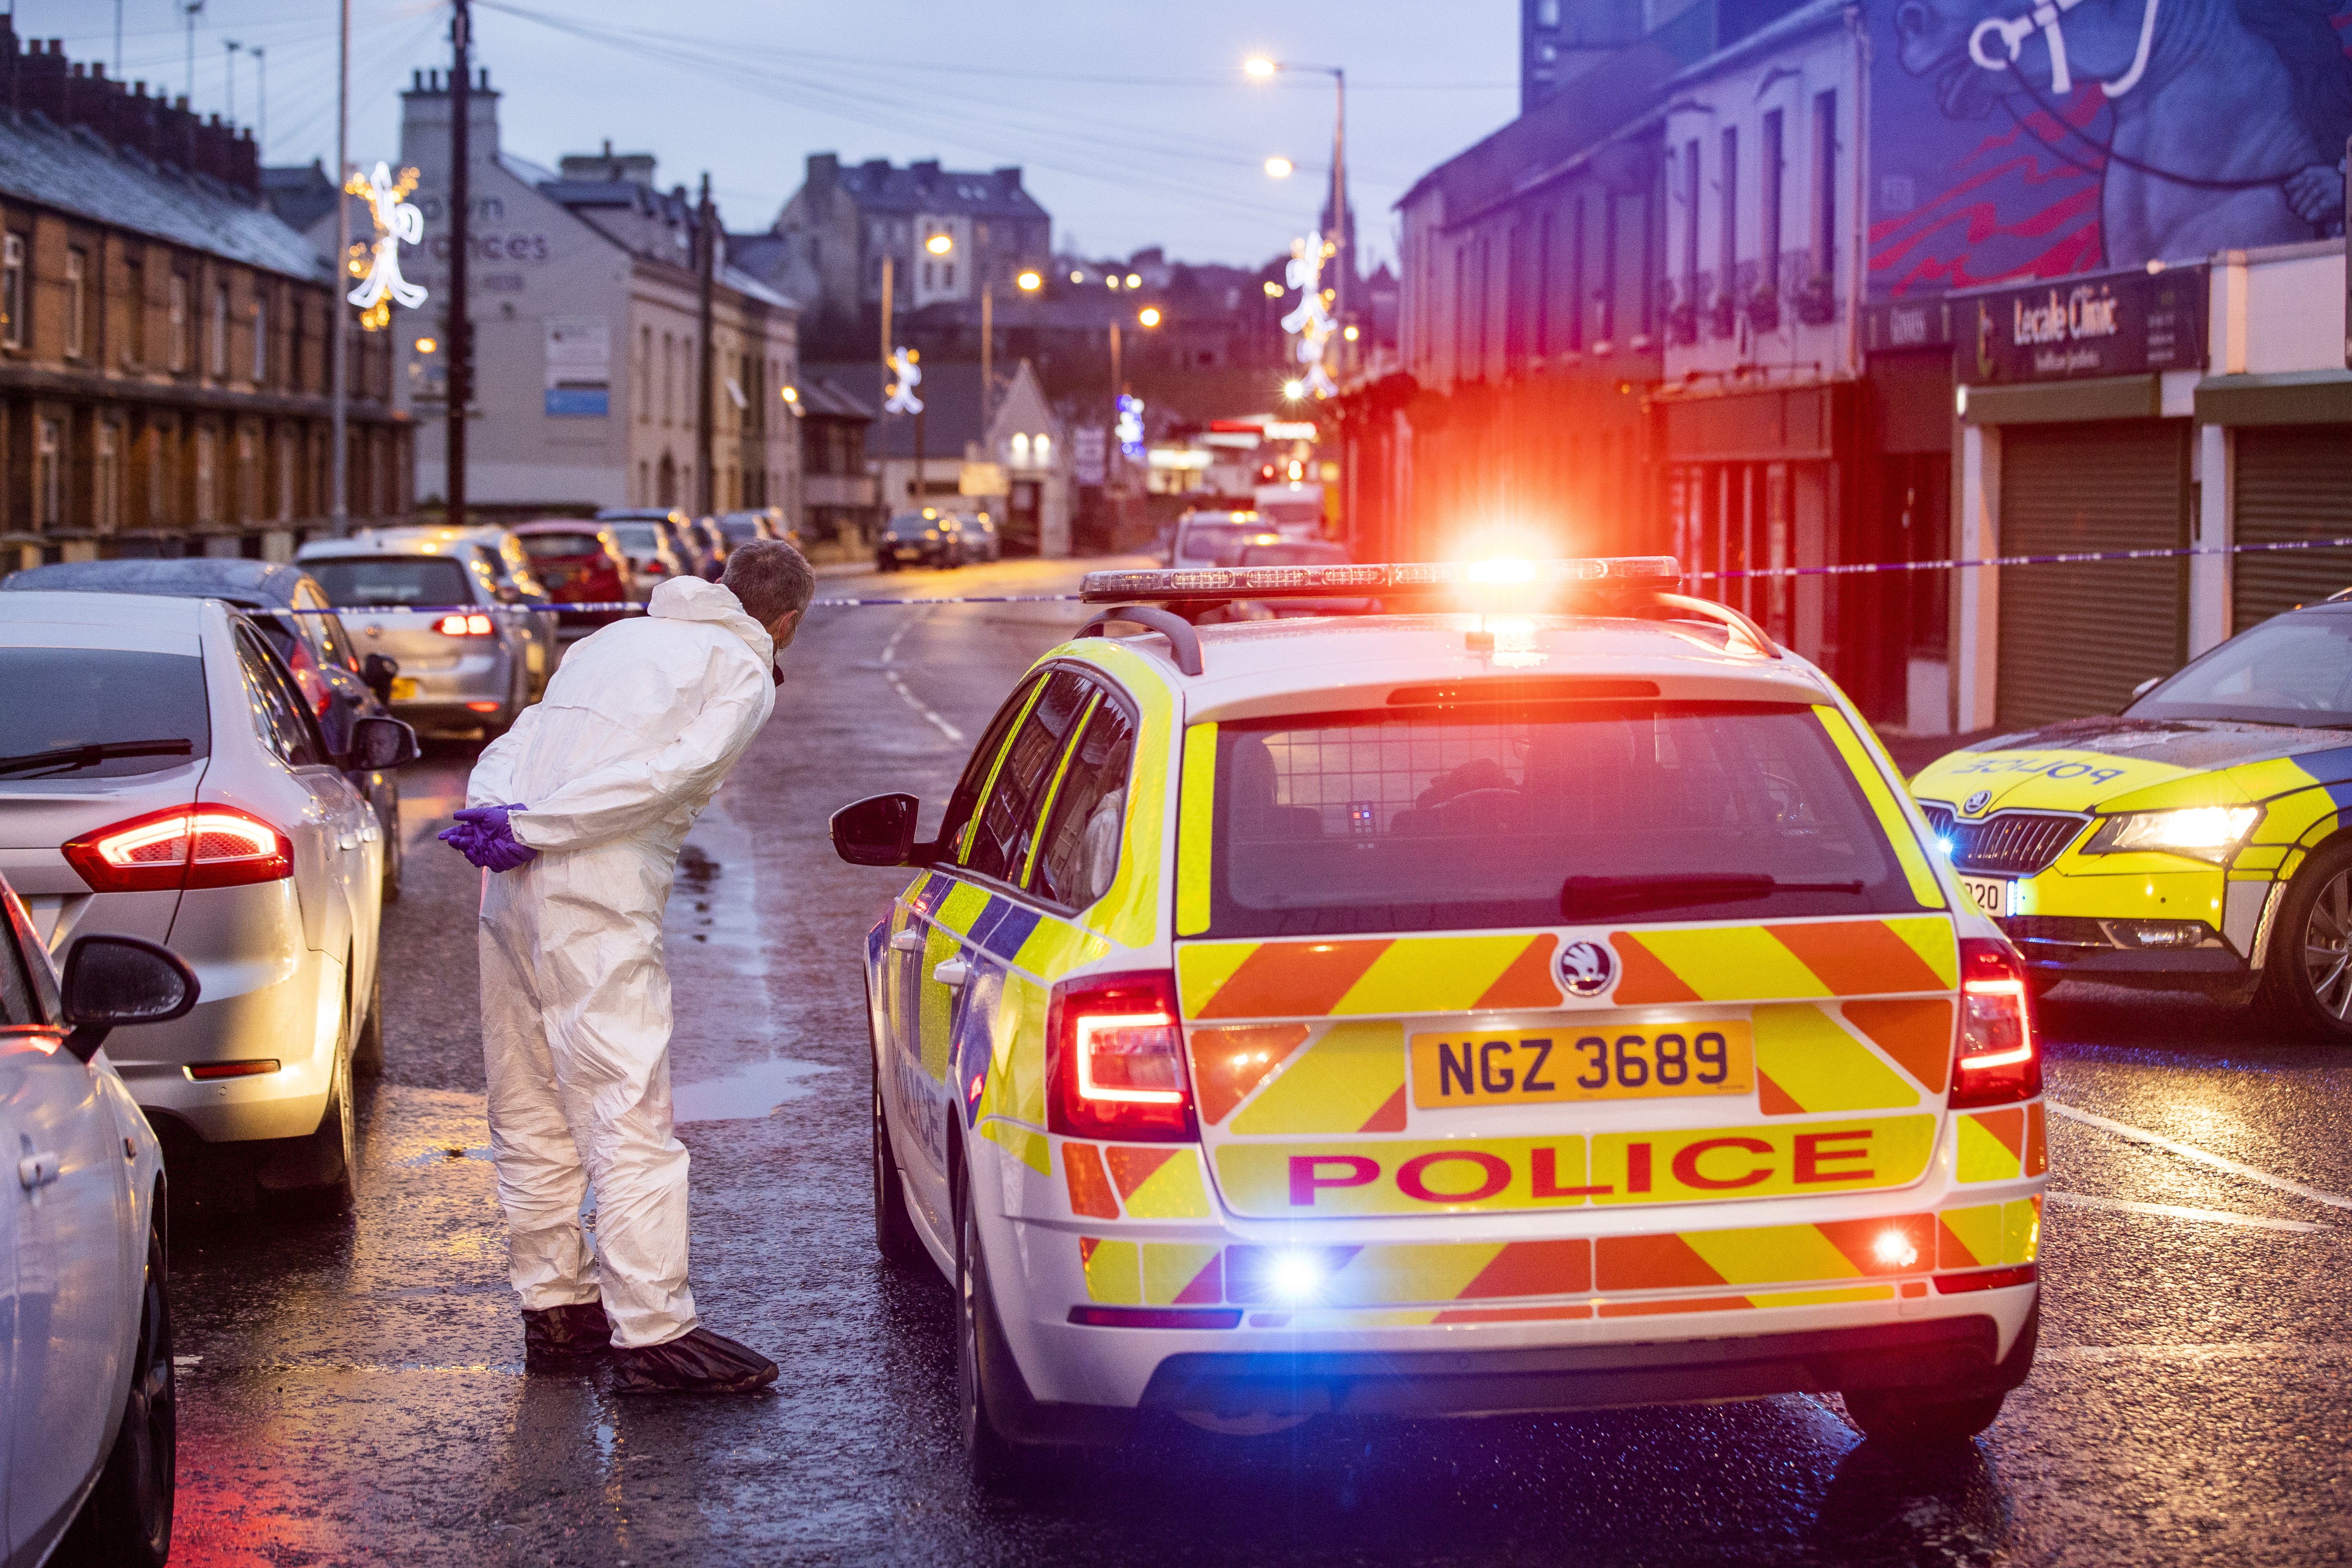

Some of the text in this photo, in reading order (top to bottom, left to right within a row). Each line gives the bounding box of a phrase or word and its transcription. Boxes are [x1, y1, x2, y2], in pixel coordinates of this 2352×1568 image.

[2069, 284, 2118, 340] Clinic
[1438, 1032, 1728, 1096] NGZ 3689
[1289, 1130, 1875, 1206] POLICE
